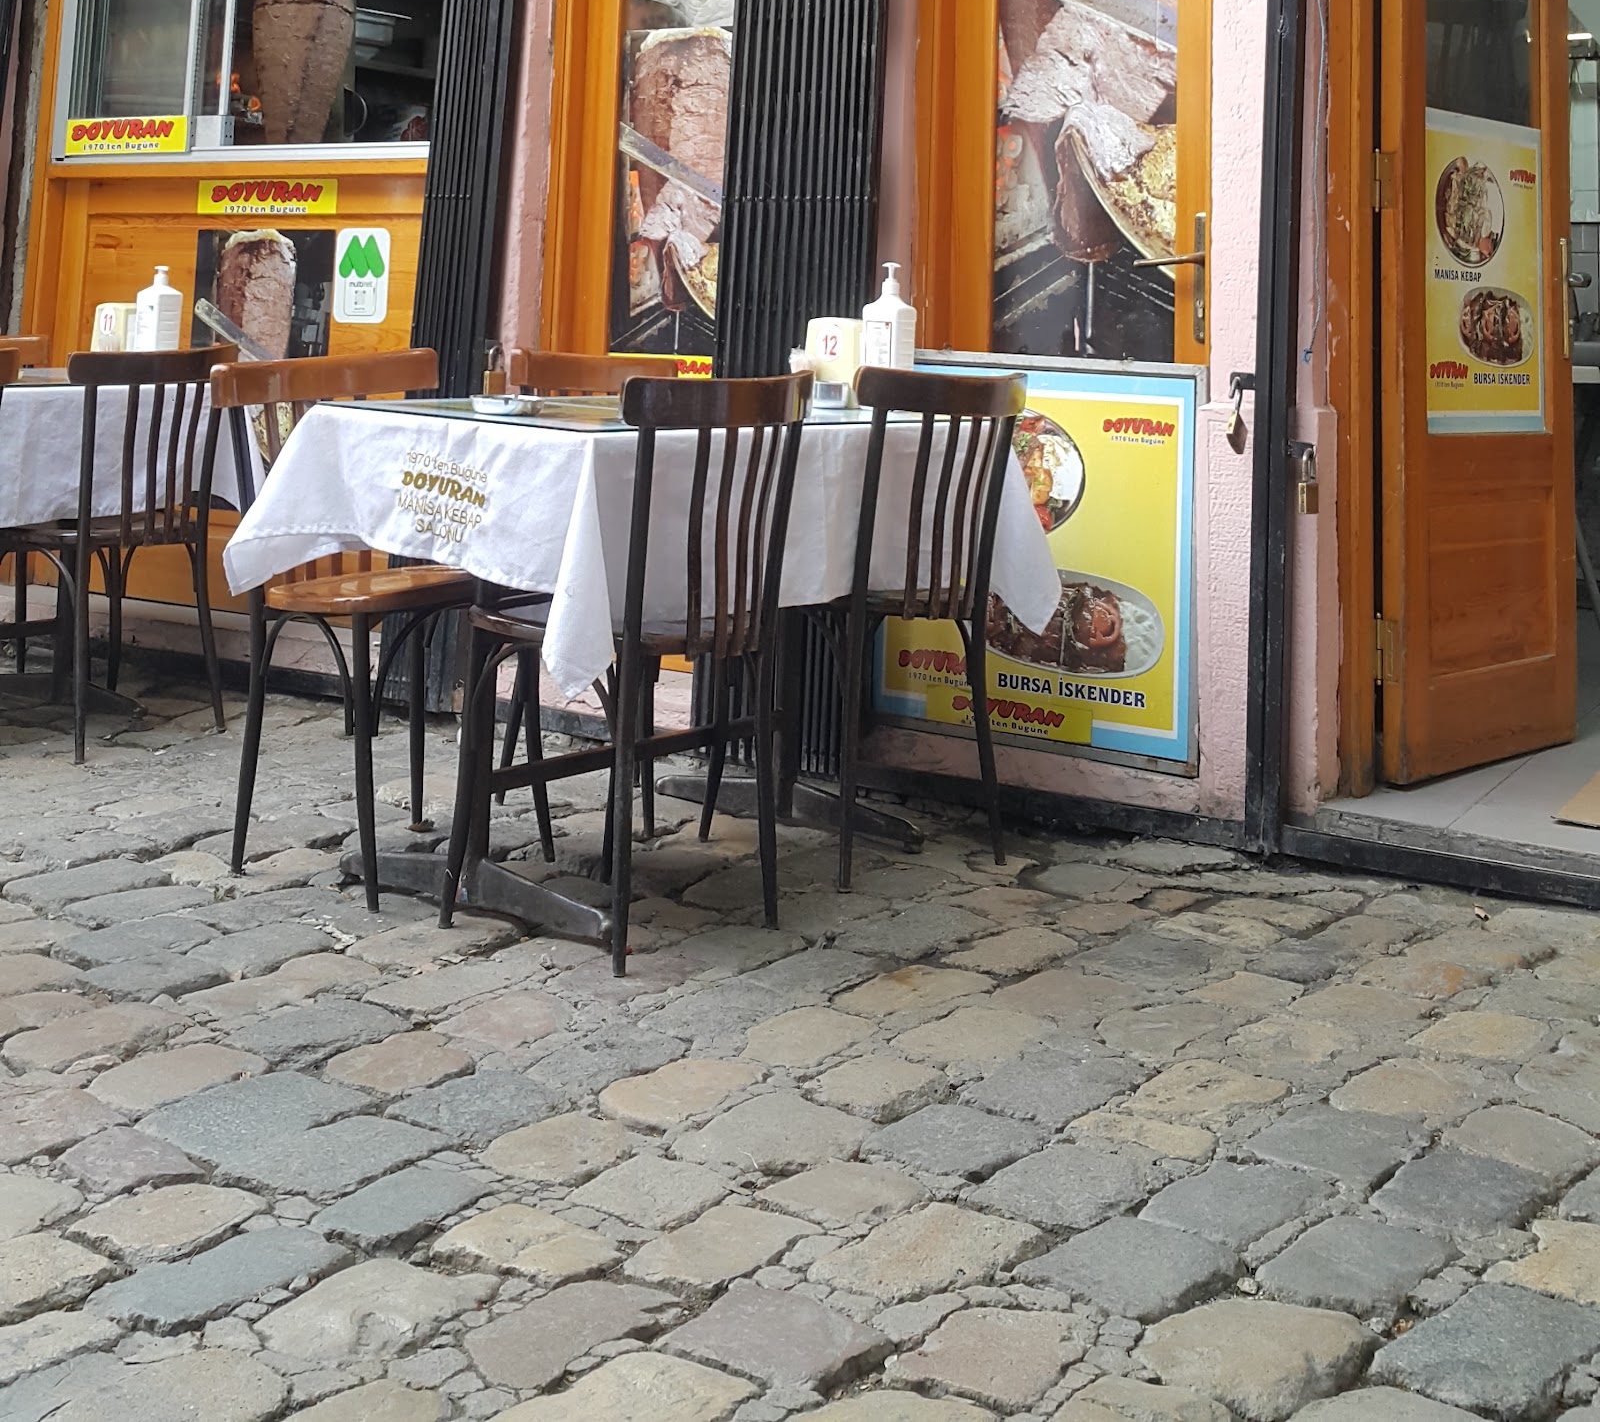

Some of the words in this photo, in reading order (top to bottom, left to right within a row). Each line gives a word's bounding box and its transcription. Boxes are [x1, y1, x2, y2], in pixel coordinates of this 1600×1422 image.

[71, 119, 174, 141] DOYURAN
[211, 180, 323, 203] DOYURAN
[1460, 271, 1482, 283] KEBAP
[103, 313, 113, 332] 11
[823, 335, 838, 356] 12
[1473, 373, 1496, 385] BURSA
[1103, 418, 1175, 436] DOYURAN
[402, 470, 486, 509] DOYURAN
[444, 503, 482, 530] KEBAP
[415, 518, 464, 543] SALONU
[998, 673, 1052, 695] BURSA
[1058, 677, 1146, 709] İSKENDER
